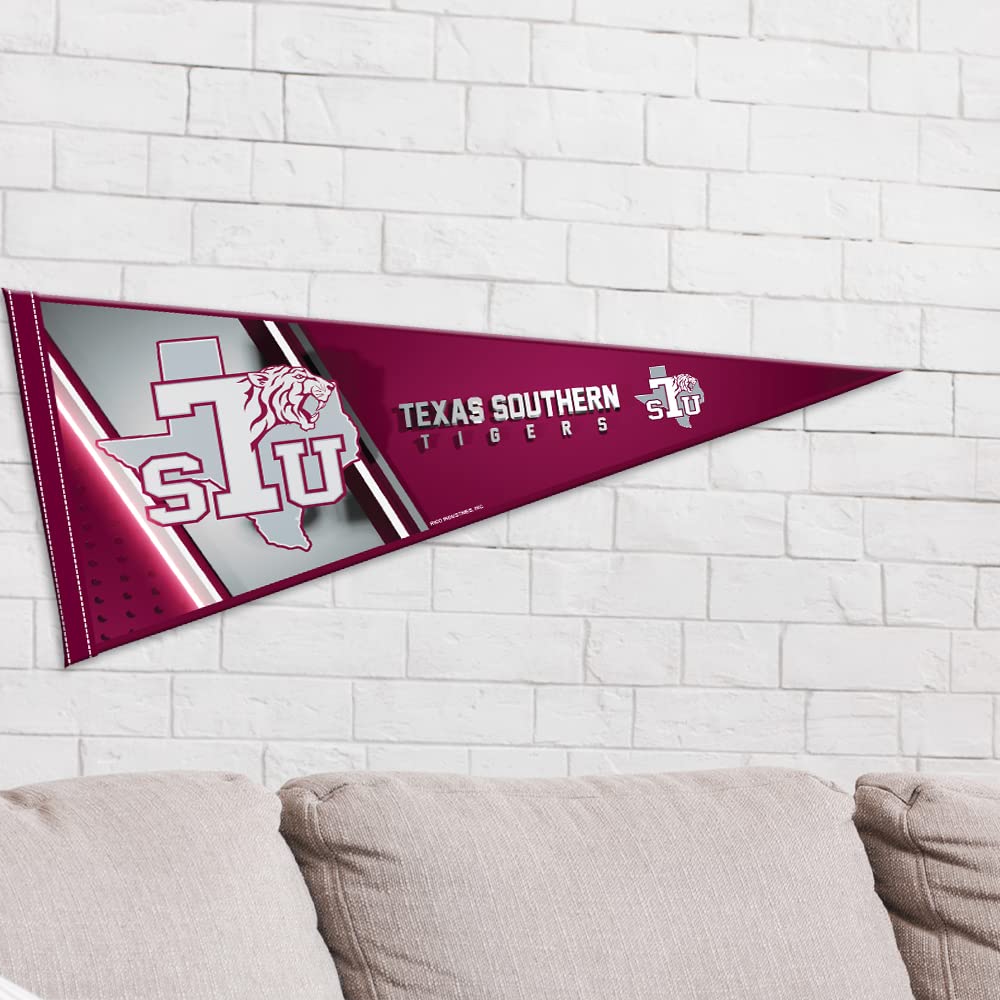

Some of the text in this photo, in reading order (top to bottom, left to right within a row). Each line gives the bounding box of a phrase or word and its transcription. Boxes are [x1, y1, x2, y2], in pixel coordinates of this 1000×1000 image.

[398, 384, 621, 429] TEXAS SOUTHERN
[420, 416, 608, 450] TIGERS
